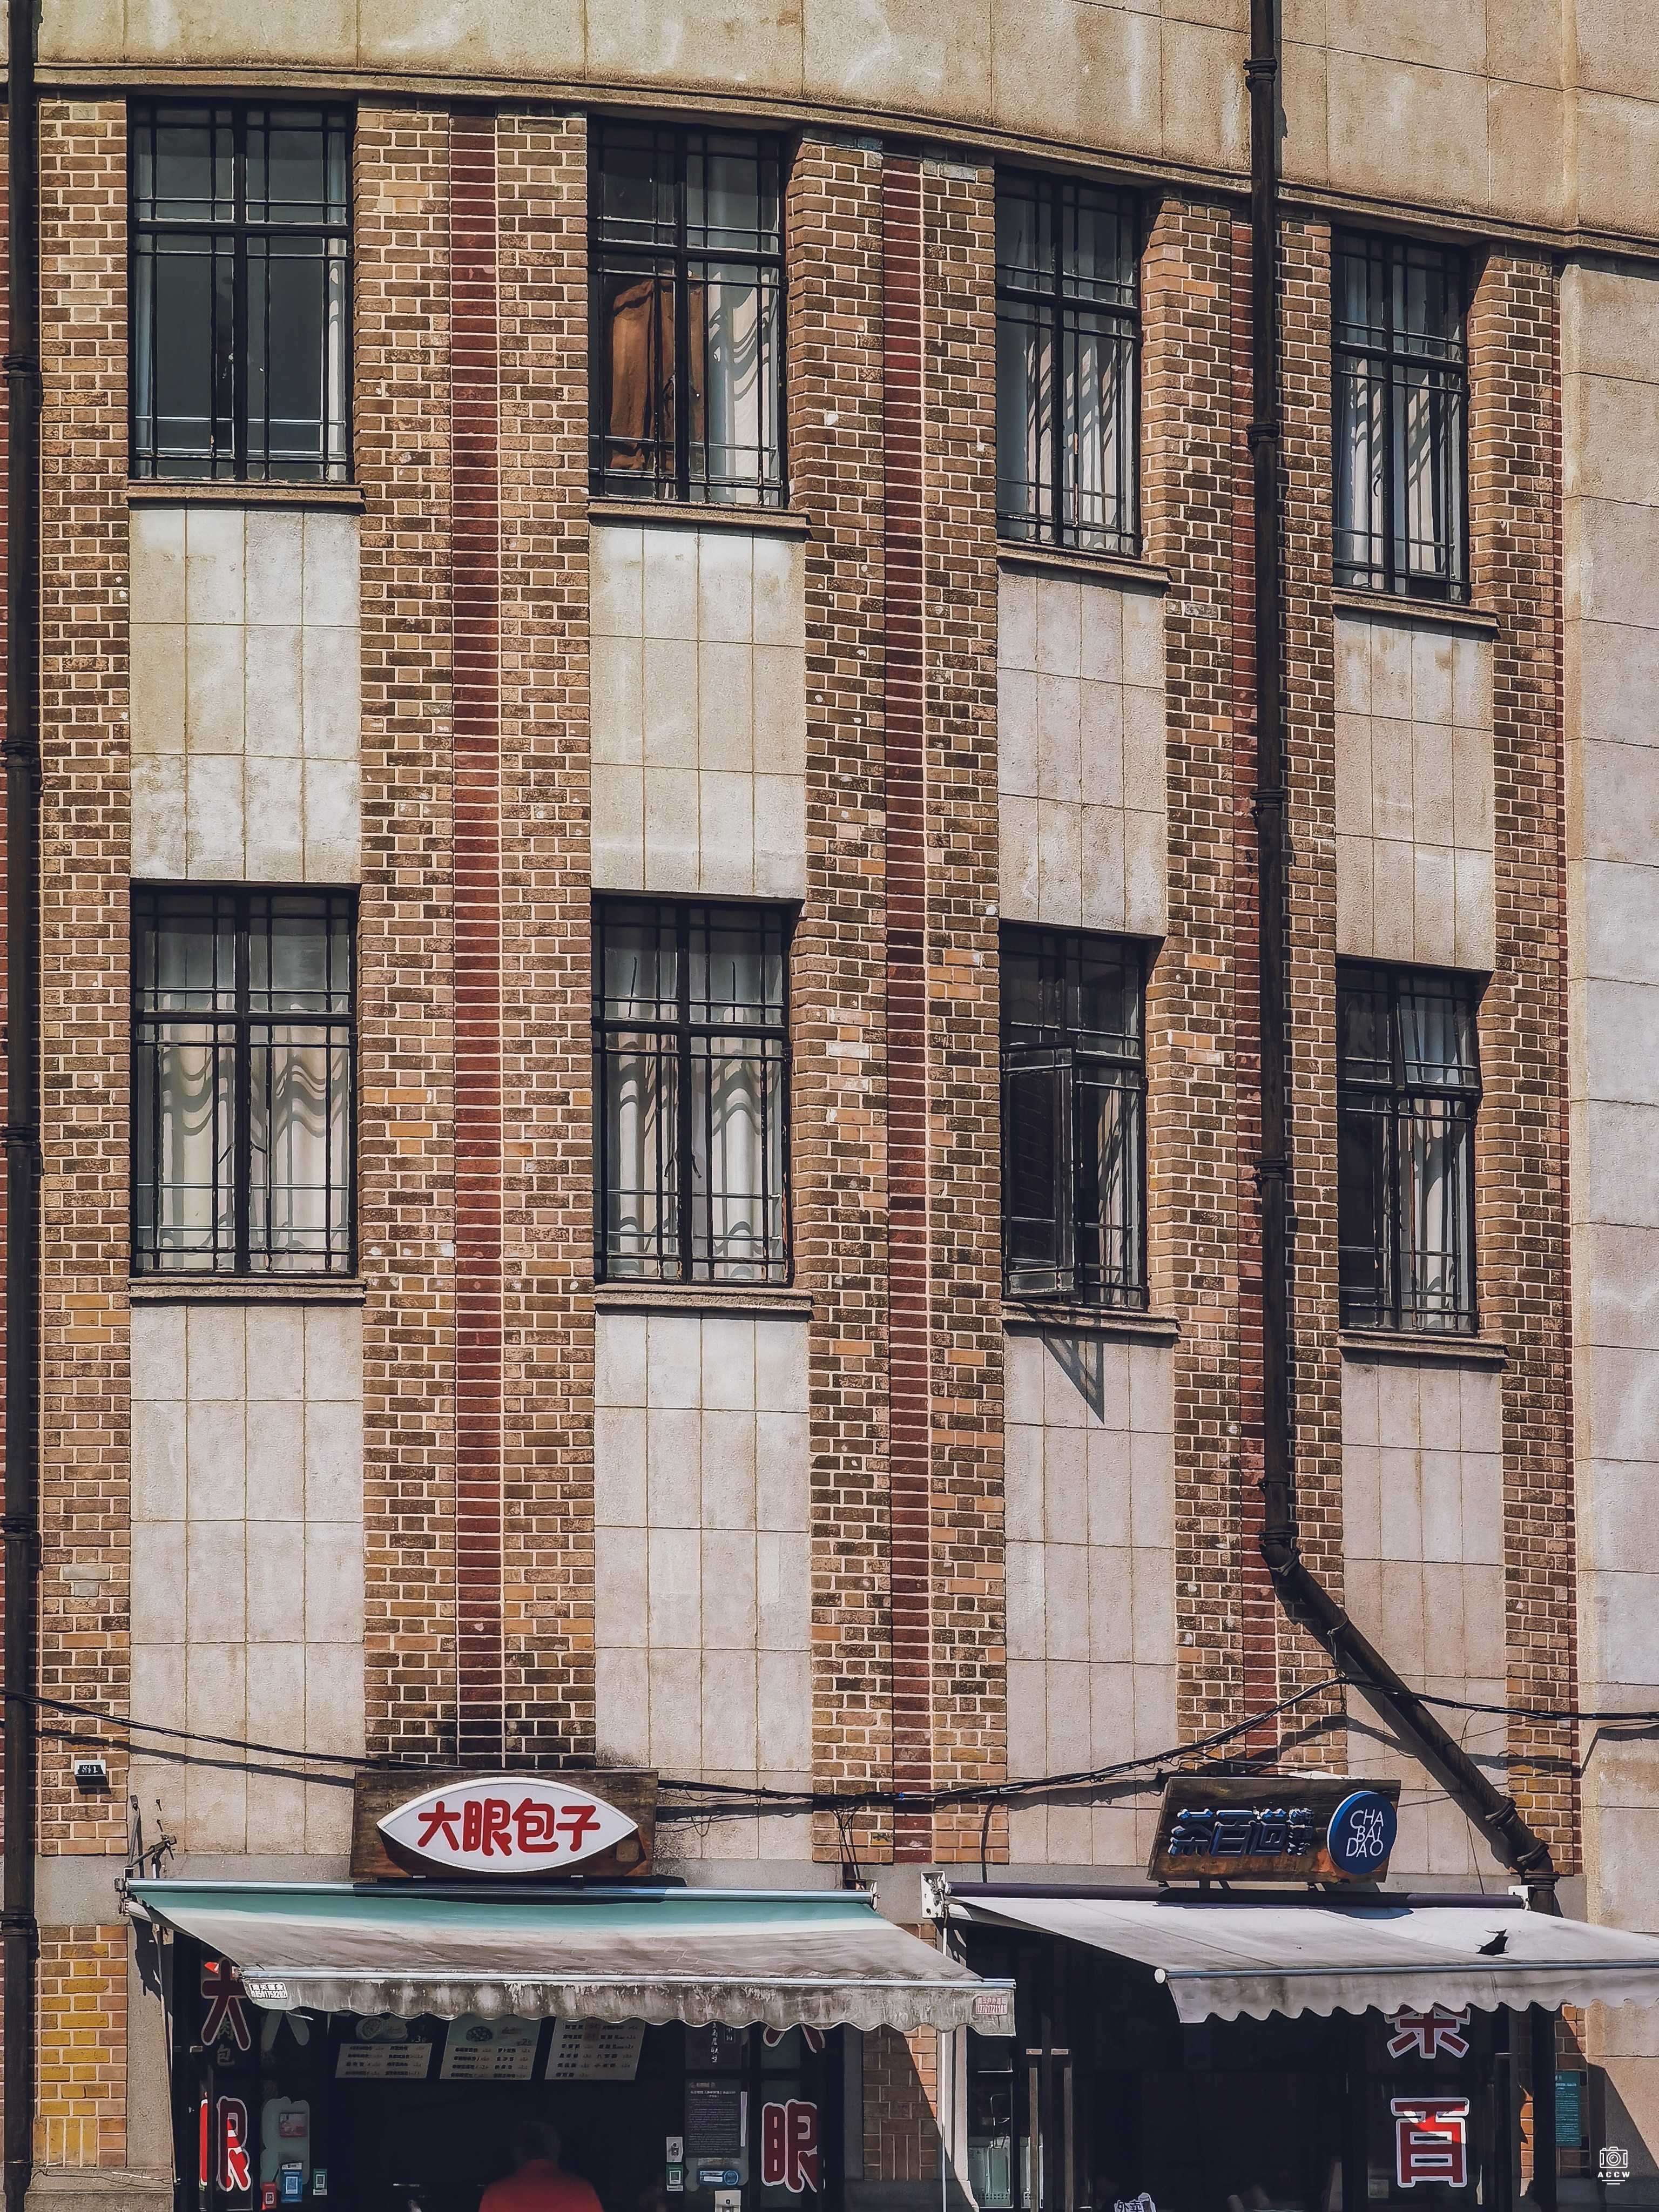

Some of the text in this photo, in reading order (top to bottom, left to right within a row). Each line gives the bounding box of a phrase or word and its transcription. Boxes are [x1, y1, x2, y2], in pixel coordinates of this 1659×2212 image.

[417, 1797, 601, 1856] 大眼包子
[1350, 1809, 1384, 1829] CHA
[1357, 1825, 1381, 1843] BAI
[1346, 1837, 1384, 1858] DAO
